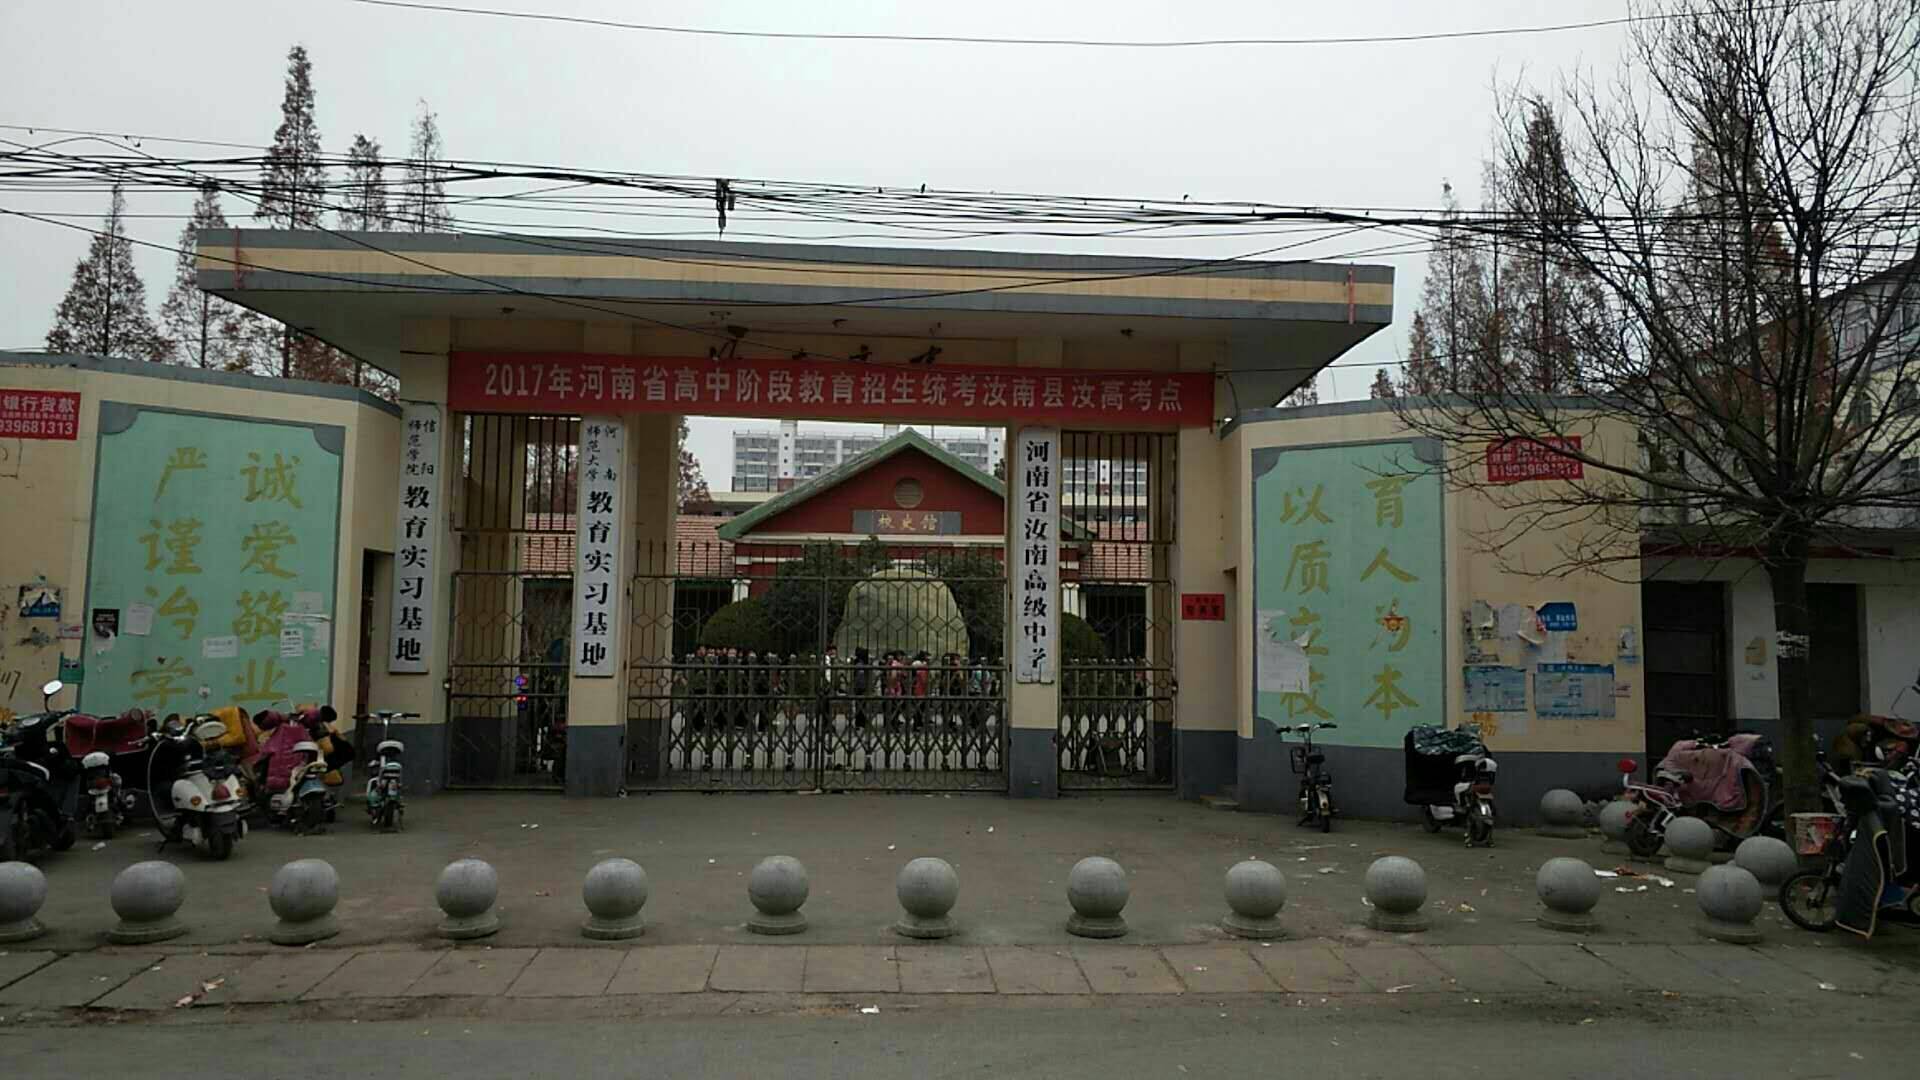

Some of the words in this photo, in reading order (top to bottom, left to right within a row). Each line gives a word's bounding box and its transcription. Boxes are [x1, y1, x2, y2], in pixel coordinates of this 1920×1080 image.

[484, 362, 1183, 413] 2017年河南省高中阶段教育招生统考汝南县汝高考点
[127, 446, 208, 708] 严谨治学
[230, 451, 304, 706] 诚爱敬业
[395, 485, 430, 663] 教育实习基地
[580, 490, 614, 667] 教育实习基地
[878, 512, 938, 531] 校史馆
[1359, 475, 1420, 721] 育人为本
